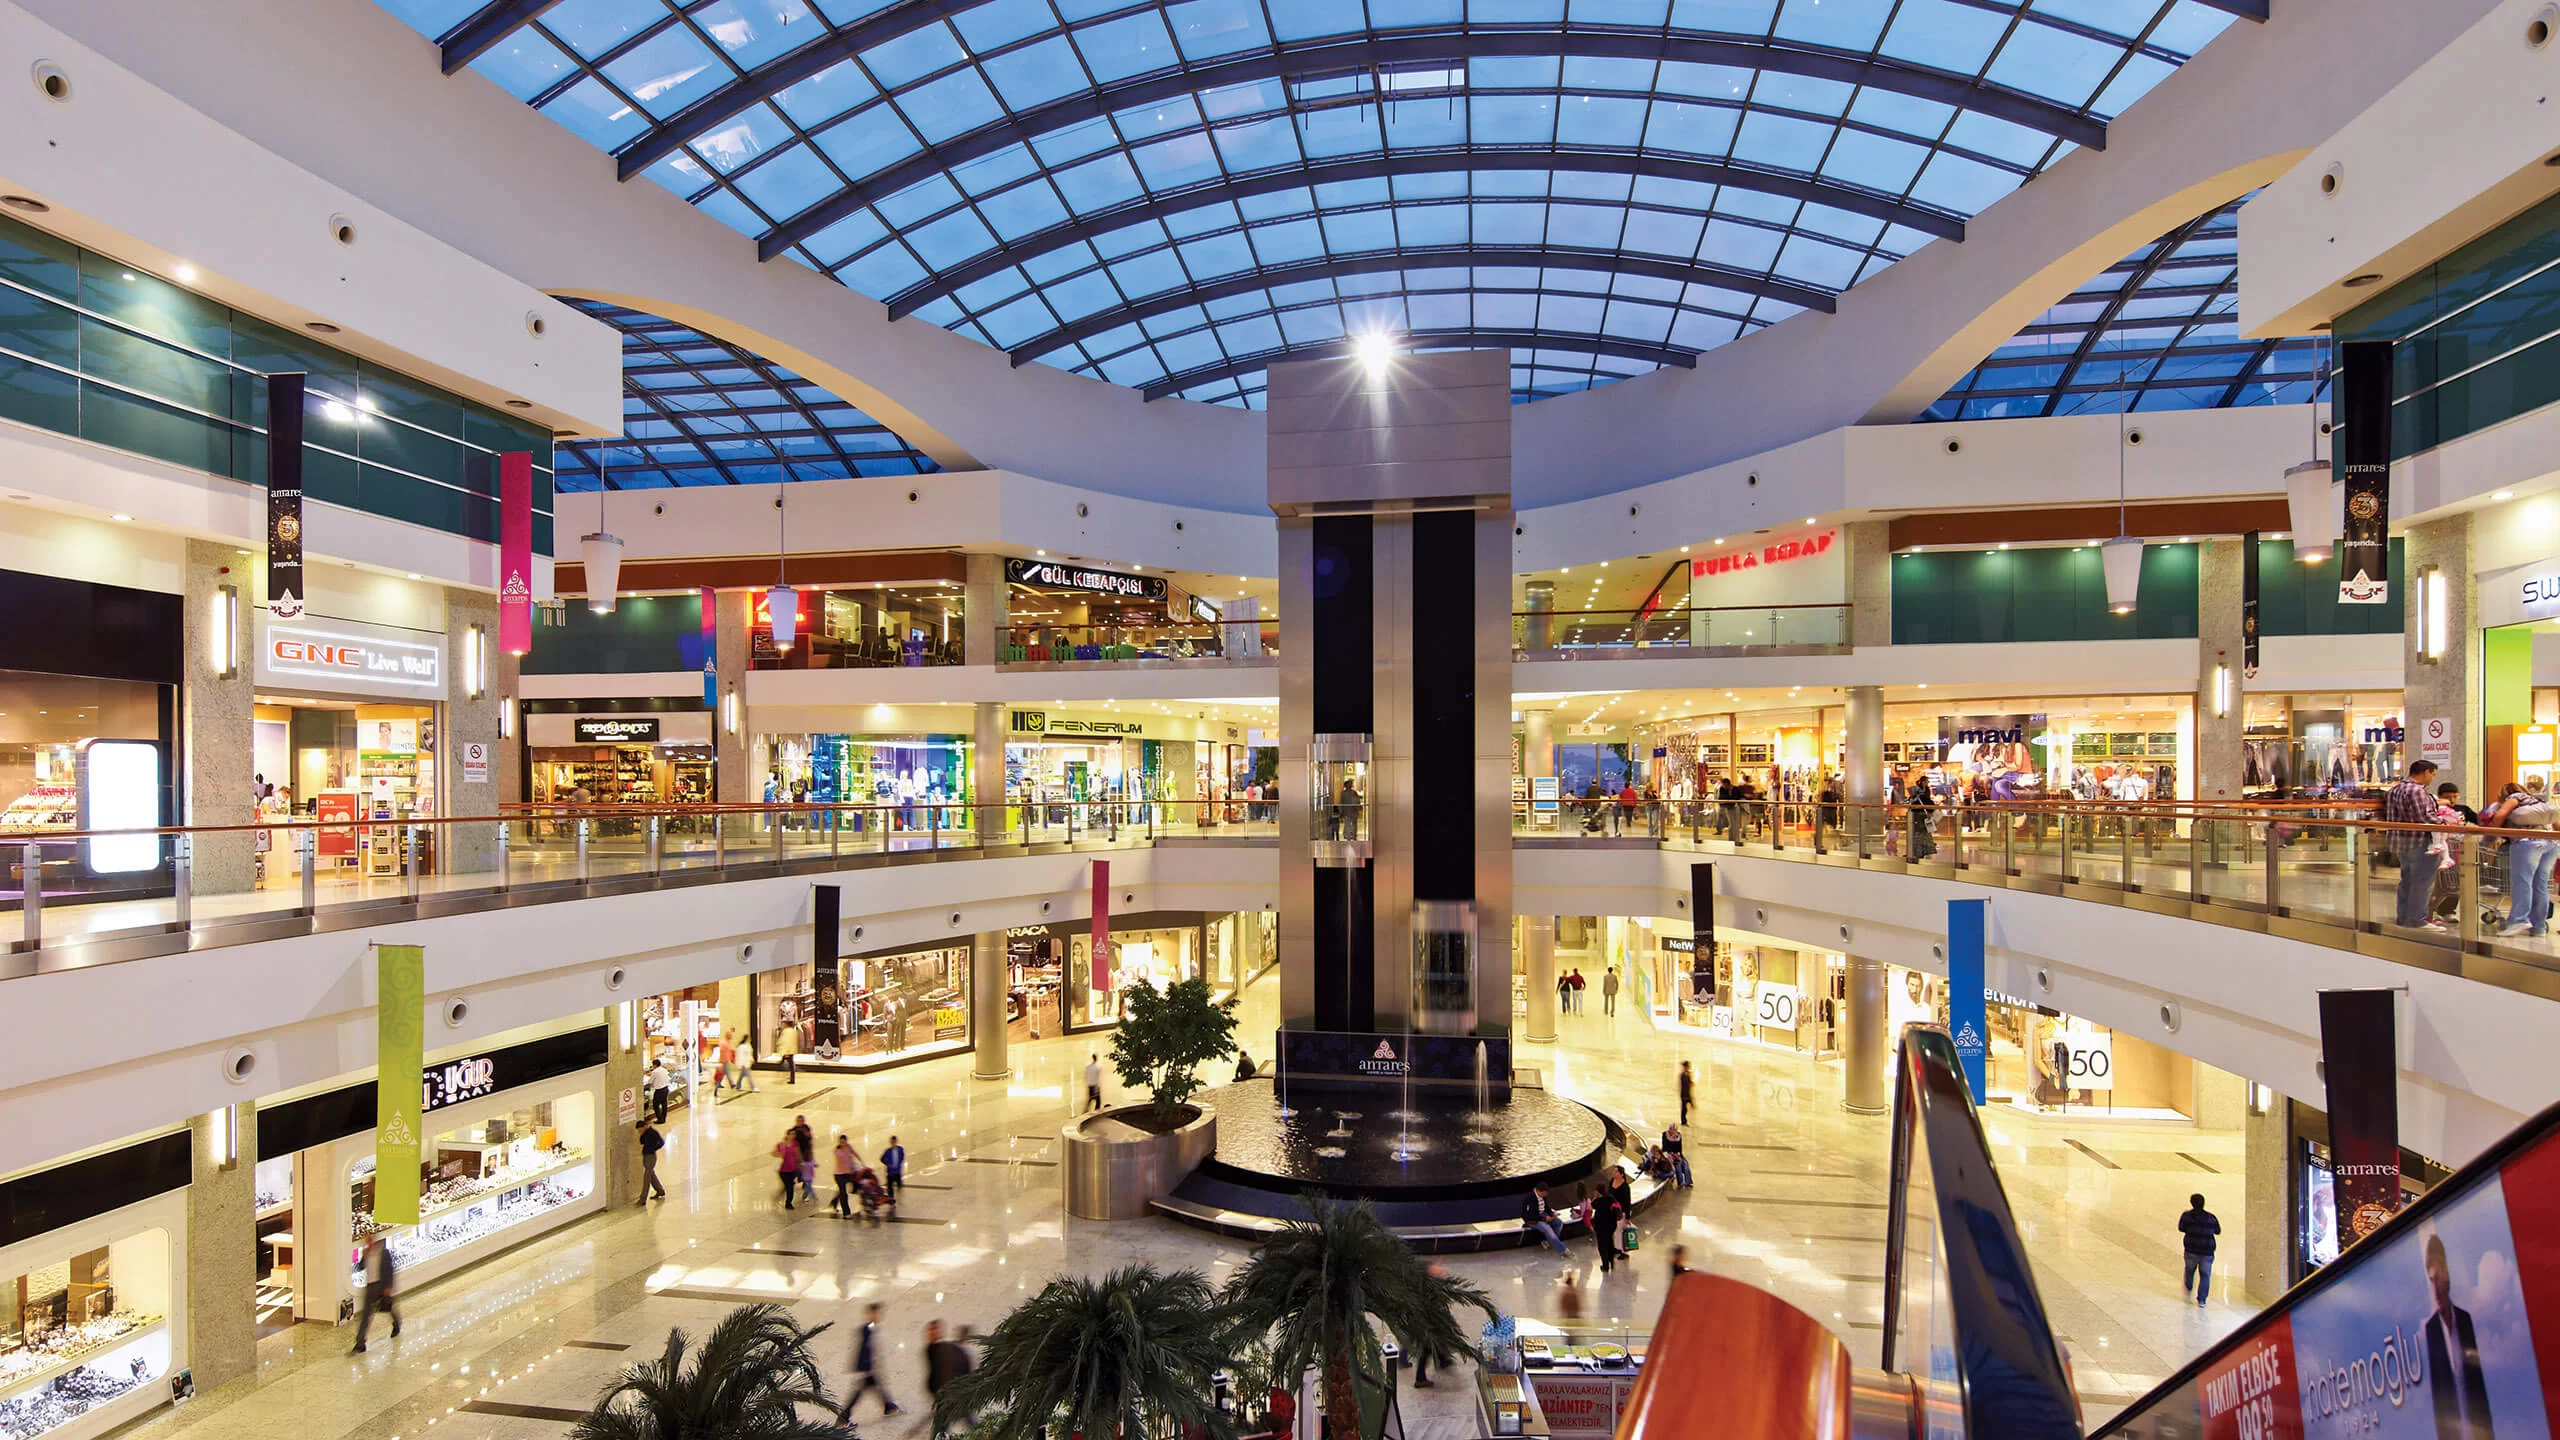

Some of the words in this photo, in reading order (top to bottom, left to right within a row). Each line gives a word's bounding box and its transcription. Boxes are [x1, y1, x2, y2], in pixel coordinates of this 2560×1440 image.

[1764, 535, 1831, 564] KEBAP
[1041, 566, 1072, 586] GÜL
[1073, 574, 1145, 595] KEBAPÇISI
[2522, 577, 2560, 604] SW
[275, 641, 360, 667] GNC
[367, 650, 399, 672] Live
[402, 656, 433, 675] Well
[1050, 720, 1143, 734] FENERIUM
[1958, 724, 2022, 744] mavi
[1759, 992, 1793, 1023] 50
[1712, 1012, 1730, 1028] 50
[1359, 1060, 1411, 1072] antares
[2069, 1049, 2110, 1078] 50
[445, 1059, 494, 1094] UĞUR
[446, 1083, 493, 1104] SAAT
[2336, 1164, 2400, 1176] antares
[1537, 1385, 1610, 1396] BAKLAVALARIMIZ
[2206, 1368, 2240, 1418] TAKIM
[2240, 1341, 2281, 1401] ELBİSE
[1541, 1396, 1593, 1414] AZİANTEP
[2344, 1410, 2381, 1433] 1924
